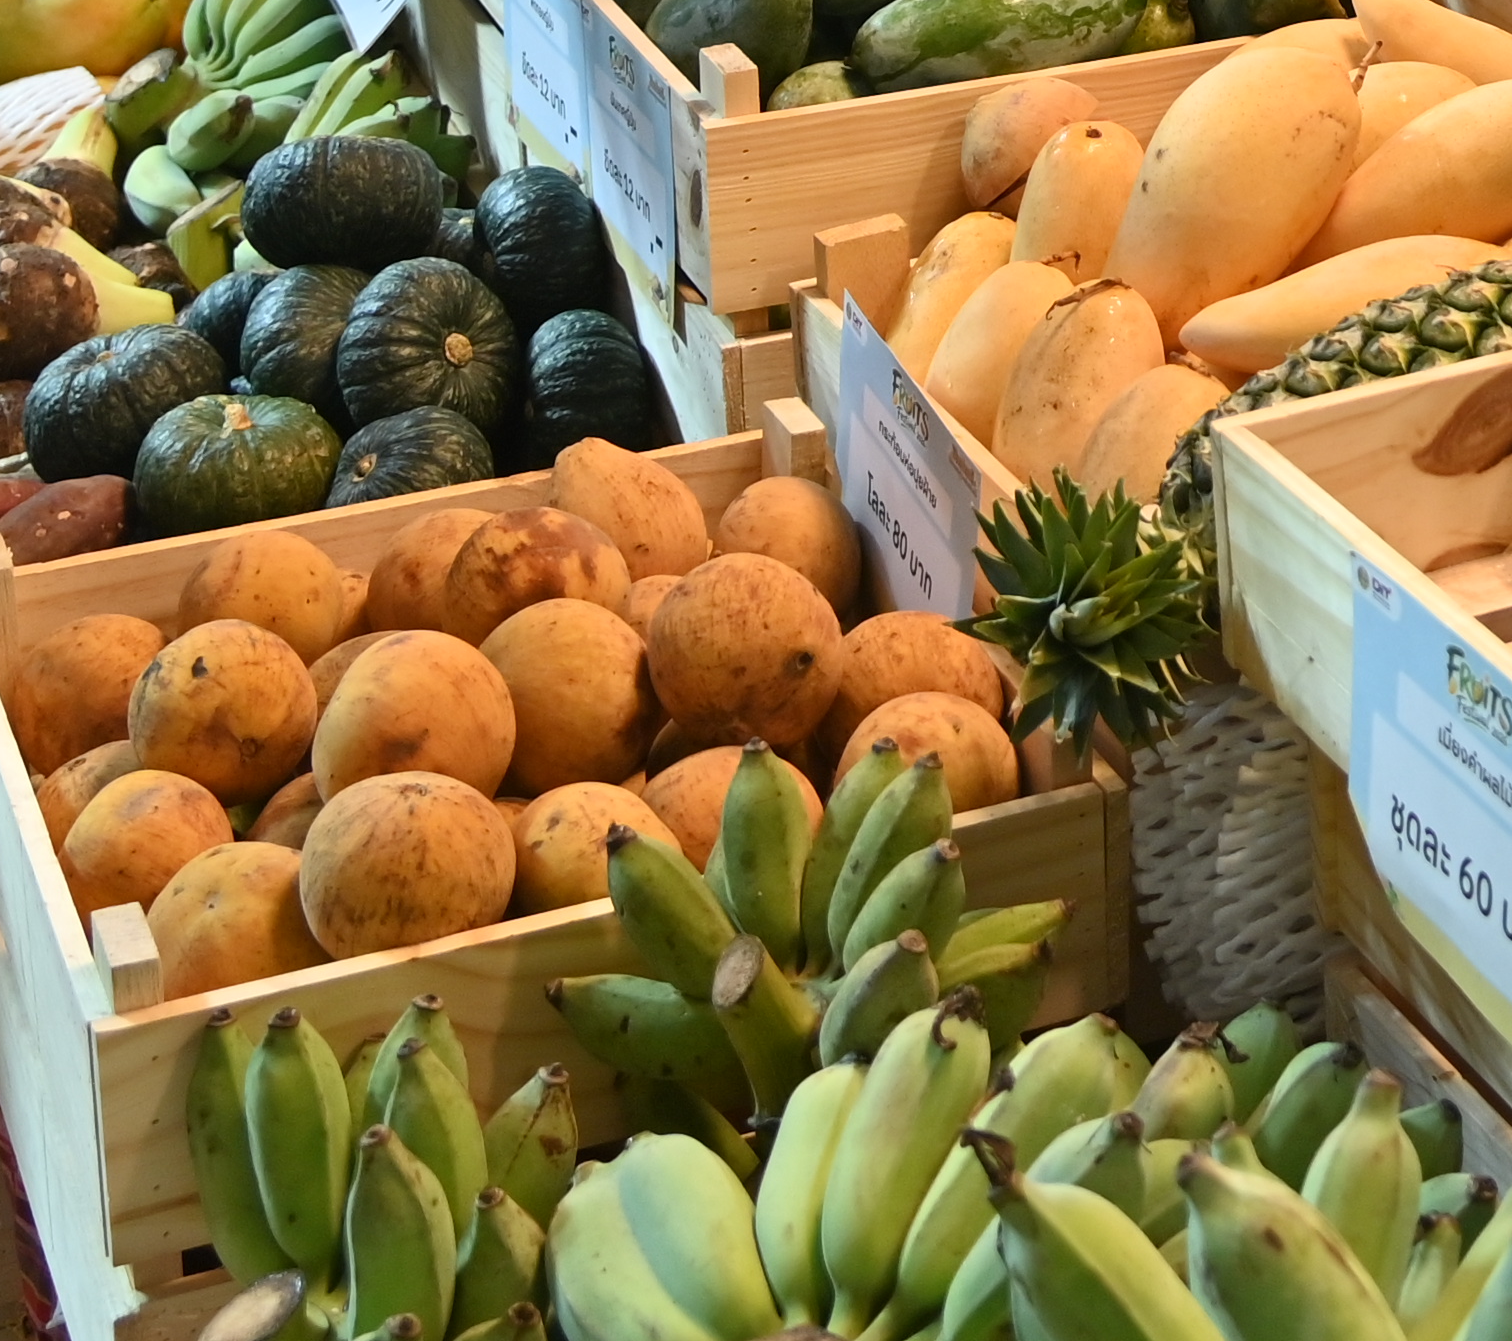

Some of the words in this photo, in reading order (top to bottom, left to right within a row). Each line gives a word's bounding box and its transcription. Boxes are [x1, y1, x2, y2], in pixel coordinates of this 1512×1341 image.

[539, 73, 549, 100] 12
[550, 91, 566, 121] บาท
[623, 173, 634, 204] 12
[635, 190, 651, 223] บาท
[866, 470, 891, 534] โลละ
[892, 519, 908, 561] 80
[910, 556, 933, 601] บาท
[1390, 792, 1452, 878] ชุดละ
[1458, 856, 1494, 918] 60
